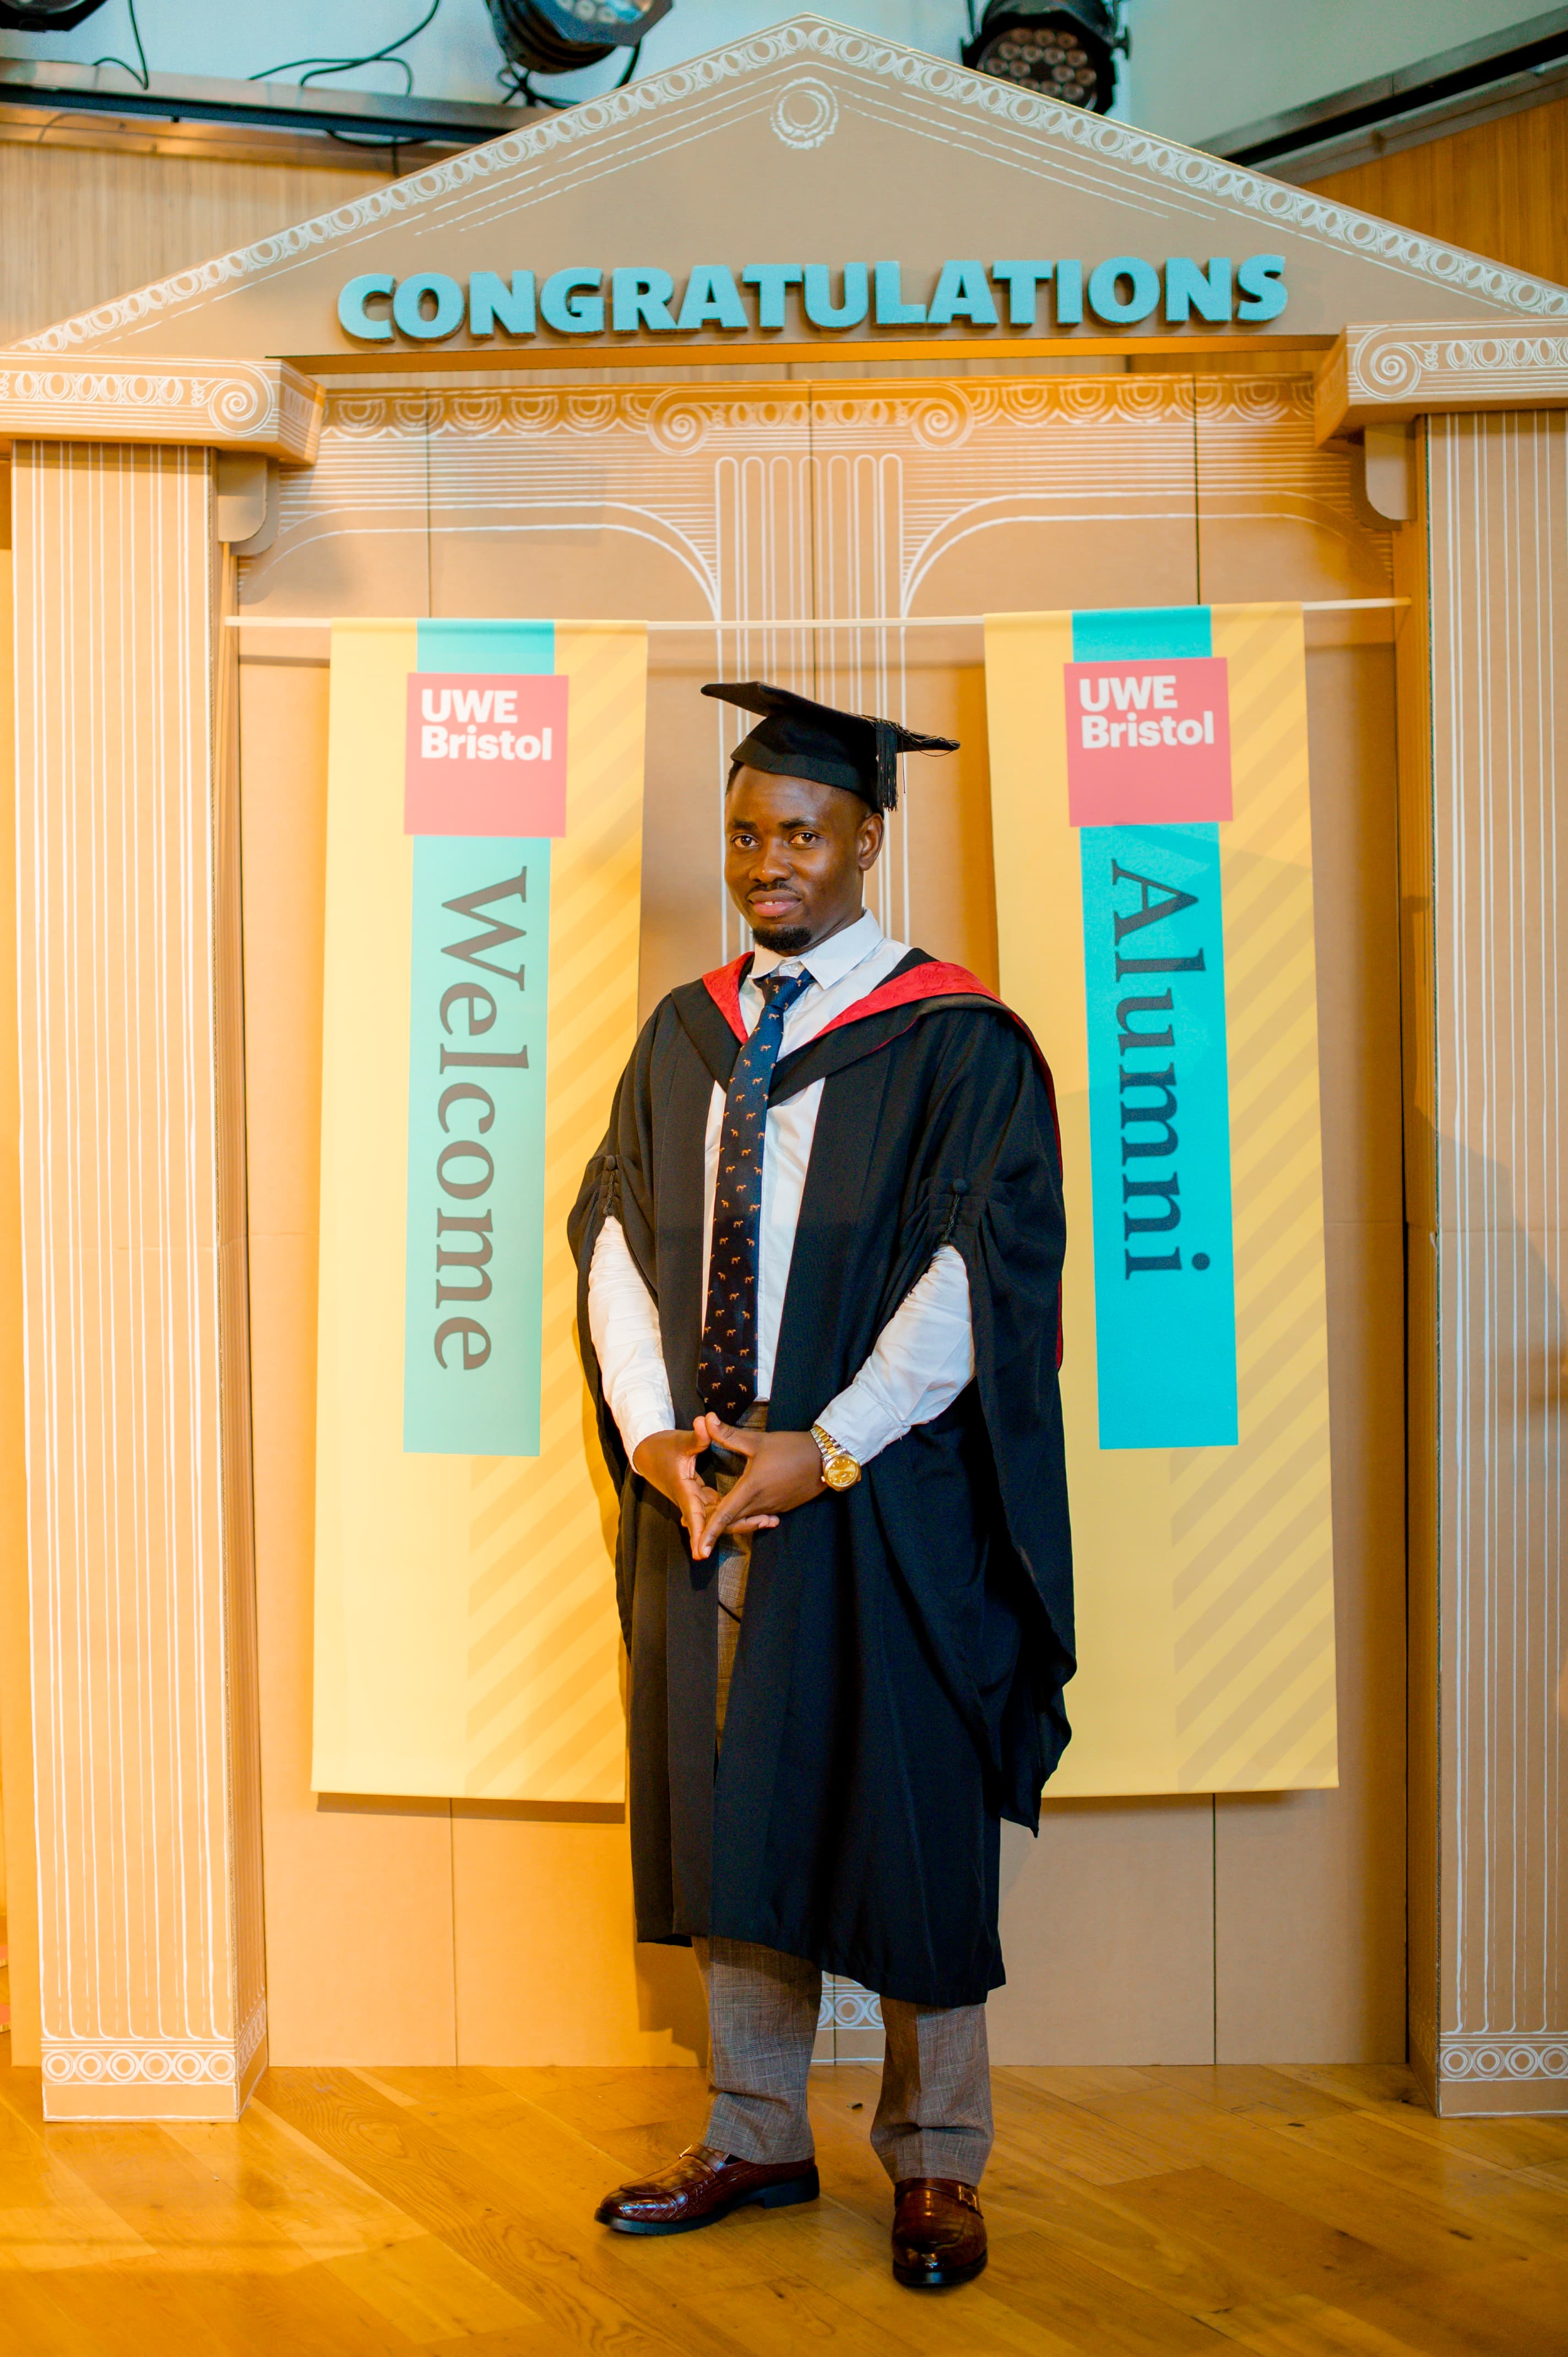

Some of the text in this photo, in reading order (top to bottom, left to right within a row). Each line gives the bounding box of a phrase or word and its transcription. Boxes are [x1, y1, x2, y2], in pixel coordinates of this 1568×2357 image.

[337, 253, 1289, 341] CONGRATULATIONS
[421, 688, 518, 723] UWE
[1079, 675, 1178, 712] UWE
[421, 724, 552, 761] Bristol
[1081, 710, 1214, 749] Bristol
[1111, 858, 1211, 1281] Alumni
[433, 865, 529, 1371] Welcome
